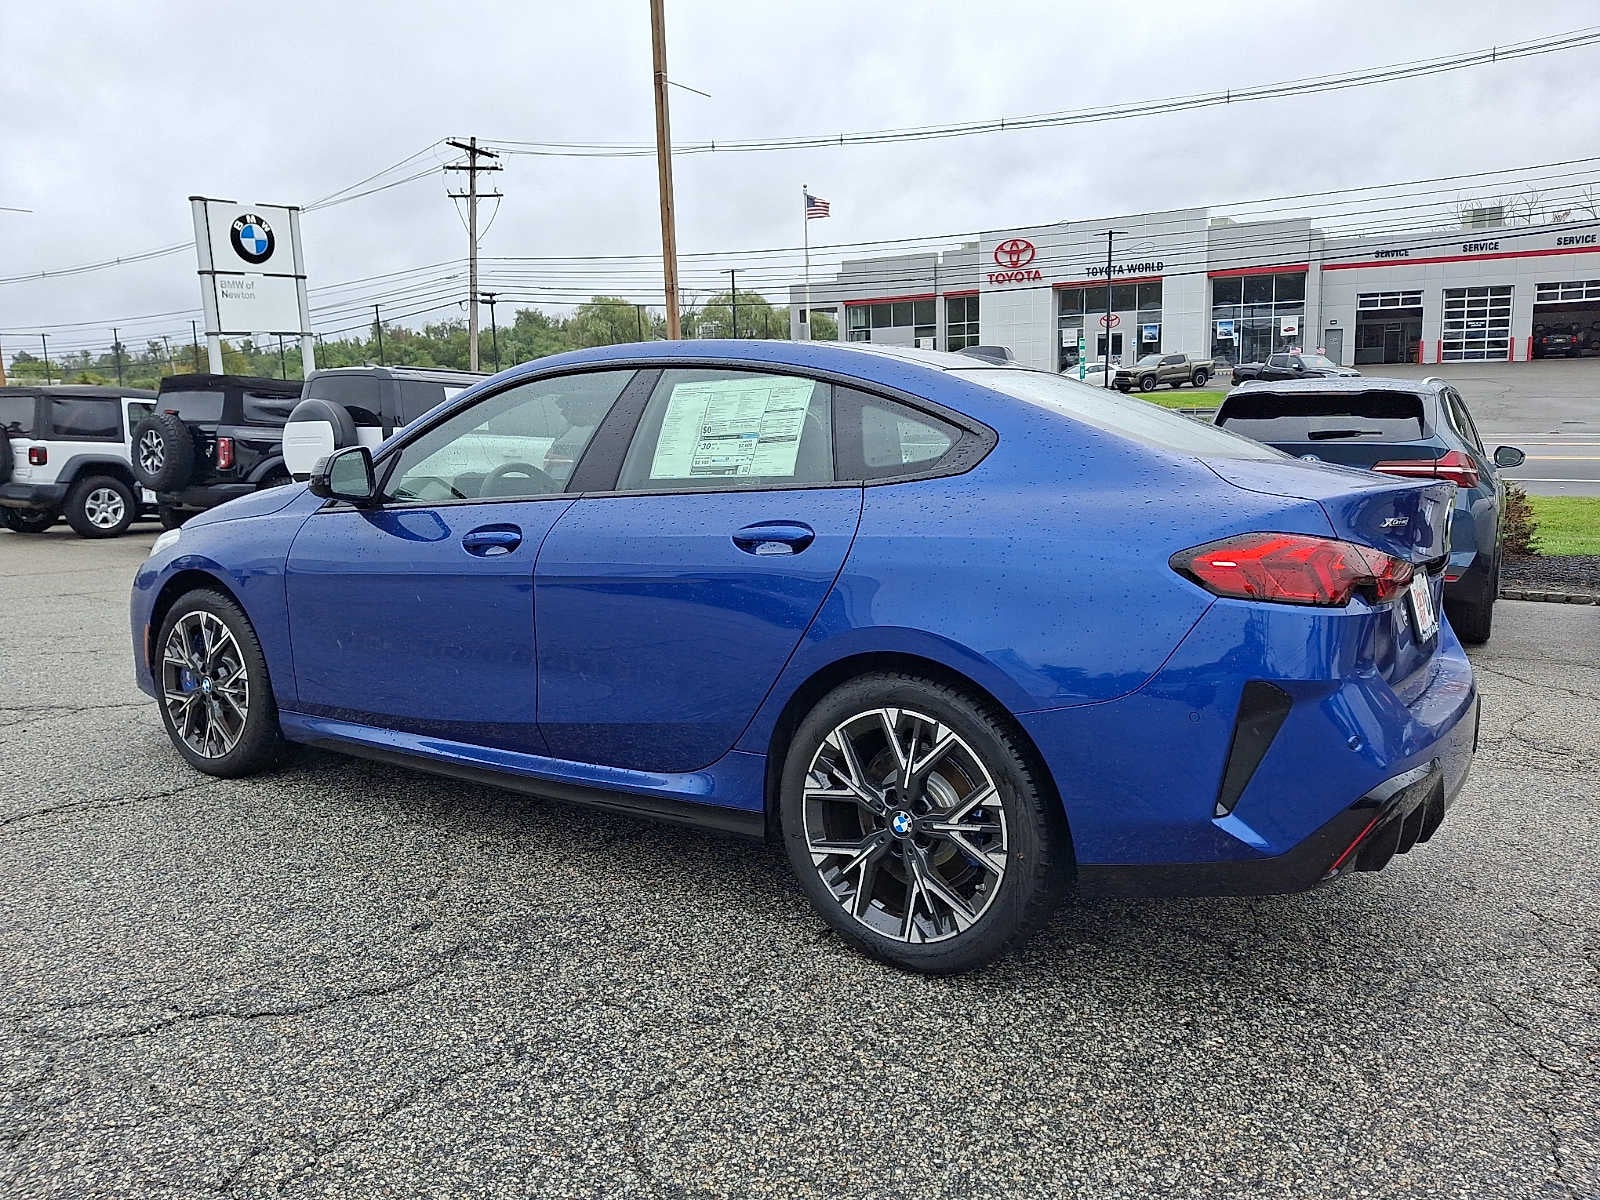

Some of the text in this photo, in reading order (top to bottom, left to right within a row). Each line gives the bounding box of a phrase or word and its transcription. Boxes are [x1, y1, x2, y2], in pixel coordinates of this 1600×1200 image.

[234, 214, 271, 232] BMW
[1556, 234, 1597, 246] SERVICE
[1463, 241, 1500, 253] SERVICE
[1375, 249, 1409, 258] SERVICE
[1127, 261, 1164, 273] WORLD
[987, 270, 1042, 285] TOYOTA
[220, 280, 254, 289] BMW of
[221, 290, 256, 300] Newton
